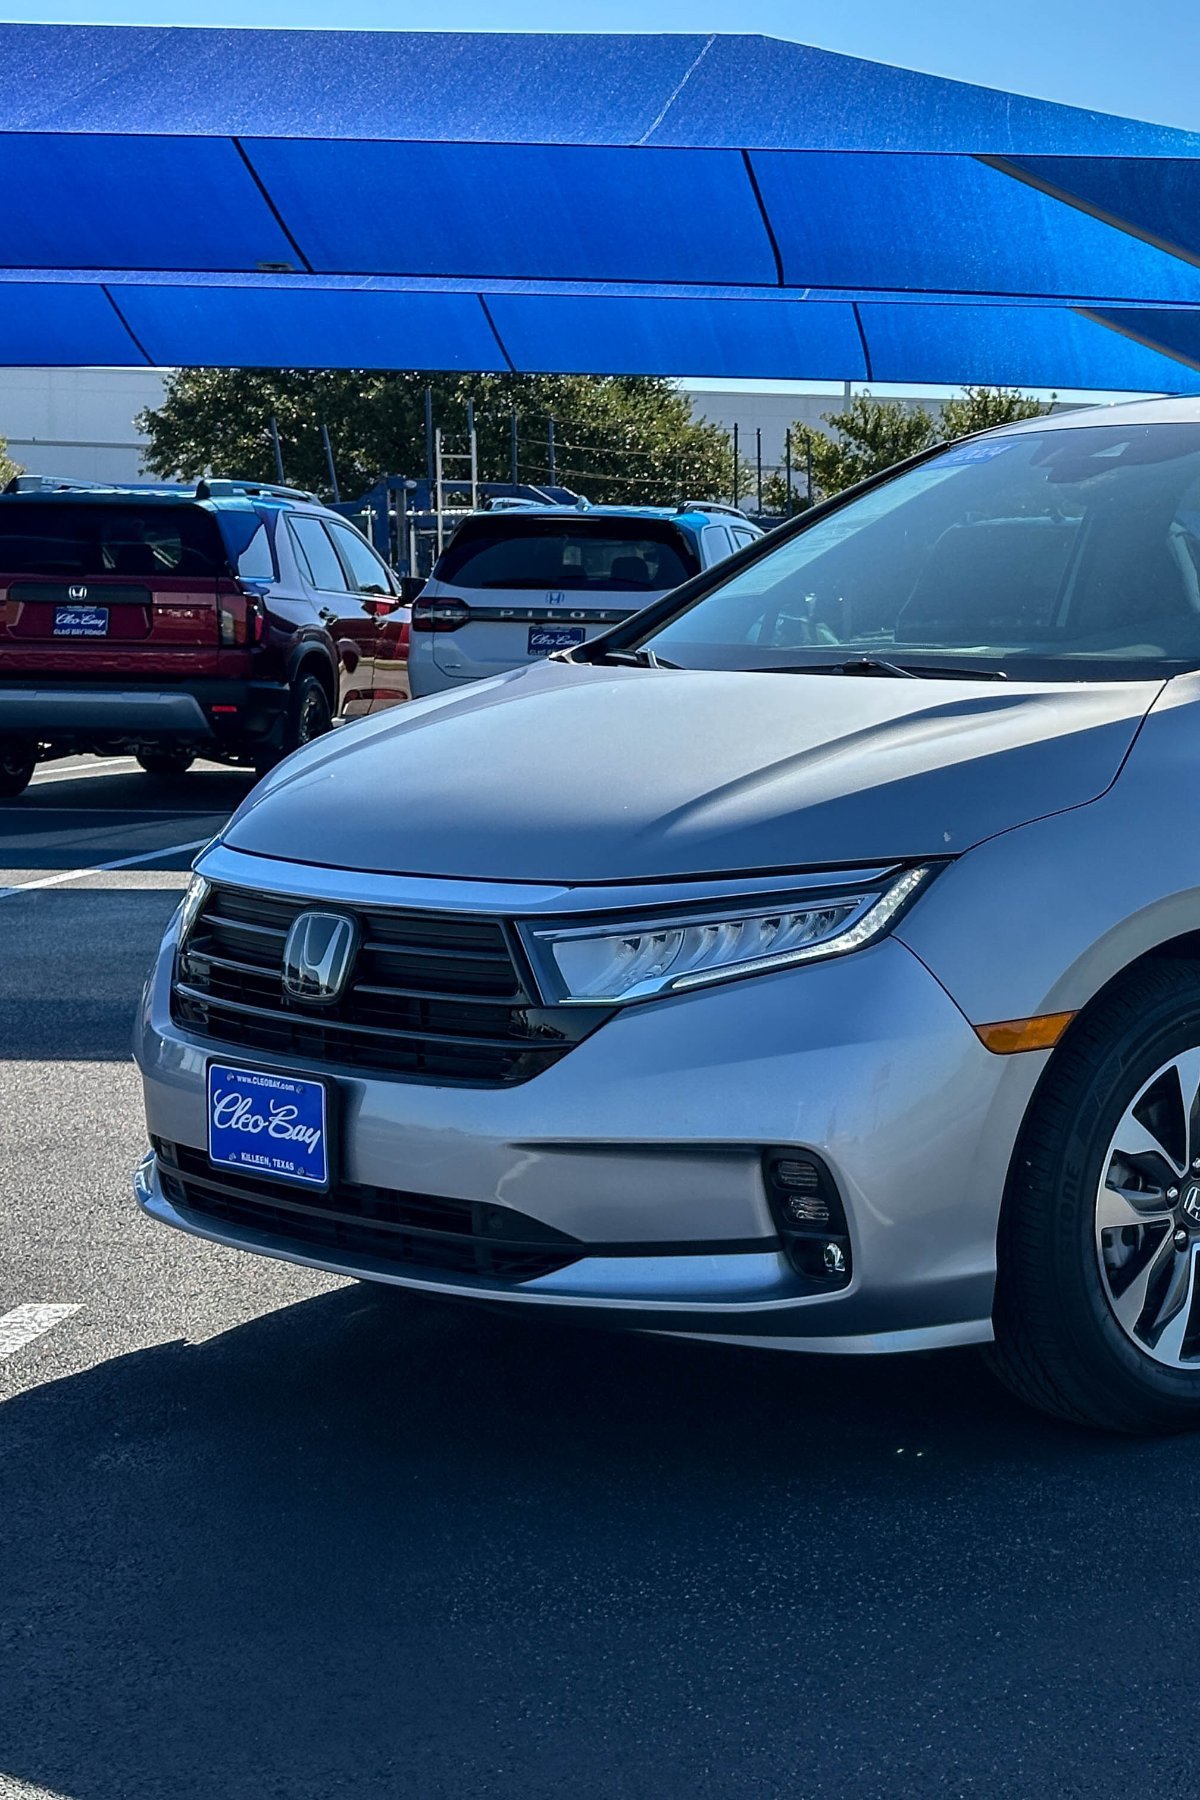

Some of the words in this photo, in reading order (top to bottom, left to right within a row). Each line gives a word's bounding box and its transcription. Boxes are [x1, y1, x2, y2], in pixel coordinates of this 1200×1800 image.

[500, 610, 609, 618] PILOT
[236, 1075, 295, 1092] www.CLEOBAY.com
[214, 1089, 268, 1133] Cleo
[268, 1099, 321, 1154] Bay
[241, 1152, 271, 1168] KILLEEN,
[272, 1158, 295, 1171] TEXAS
